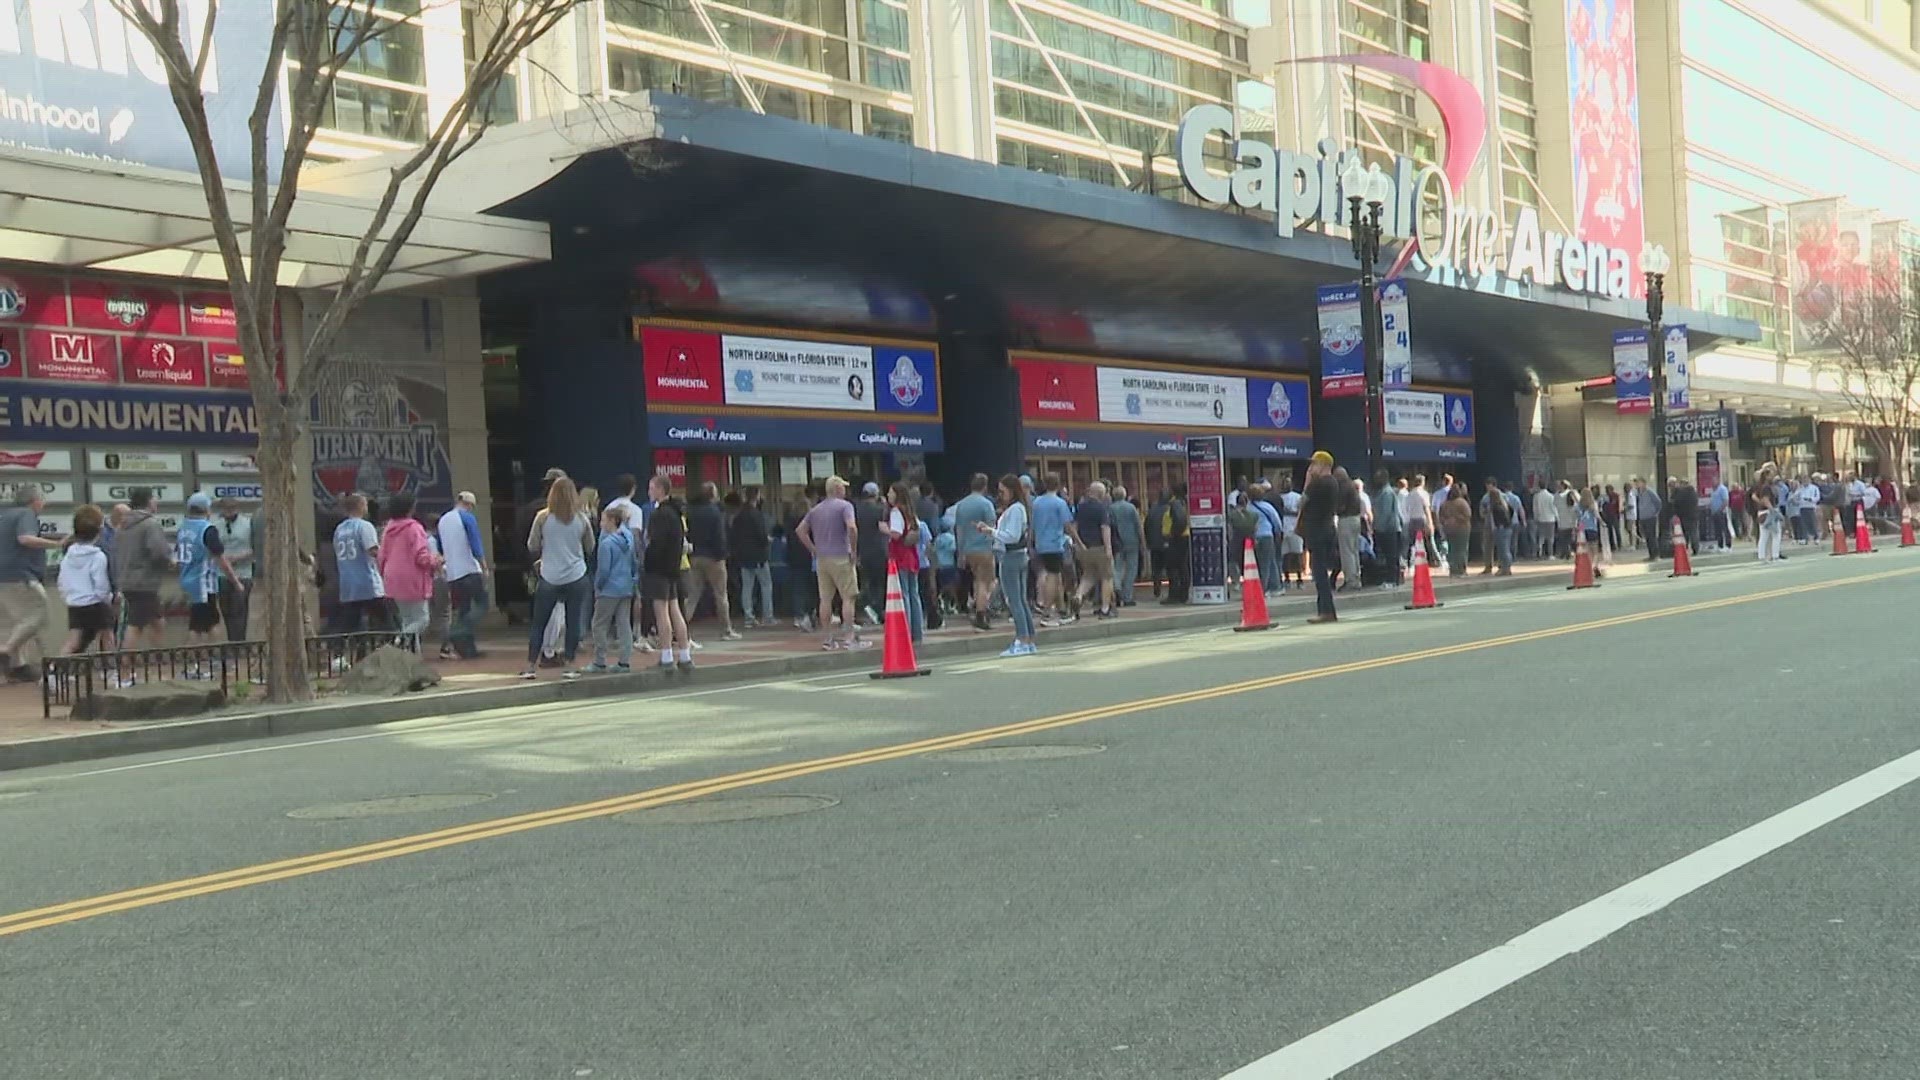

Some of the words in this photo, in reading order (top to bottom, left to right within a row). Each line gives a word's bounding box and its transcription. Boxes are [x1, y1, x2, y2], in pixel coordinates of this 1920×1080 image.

[1507, 206, 1631, 300] Arena
[1384, 313, 1395, 331] 2
[1396, 331, 1407, 348] 4
[728, 348, 753, 360] NORTH
[754, 350, 789, 363] CAROLINA
[797, 353, 826, 365] FLORIDA
[827, 356, 846, 368] STATE
[1666, 351, 1676, 364] 2
[38, 364, 108, 375] MONUMENTAL
[1677, 363, 1686, 376] 4
[657, 376, 709, 389] MONUMENTAL
[21, 397, 260, 434] MONUMENTAL
[1685, 417, 1728, 431] OFFICE
[668, 427, 702, 441] Capital
[718, 430, 746, 442] Arena
[899, 436, 922, 446] Arena
[1664, 428, 1728, 443] NTRANCE
